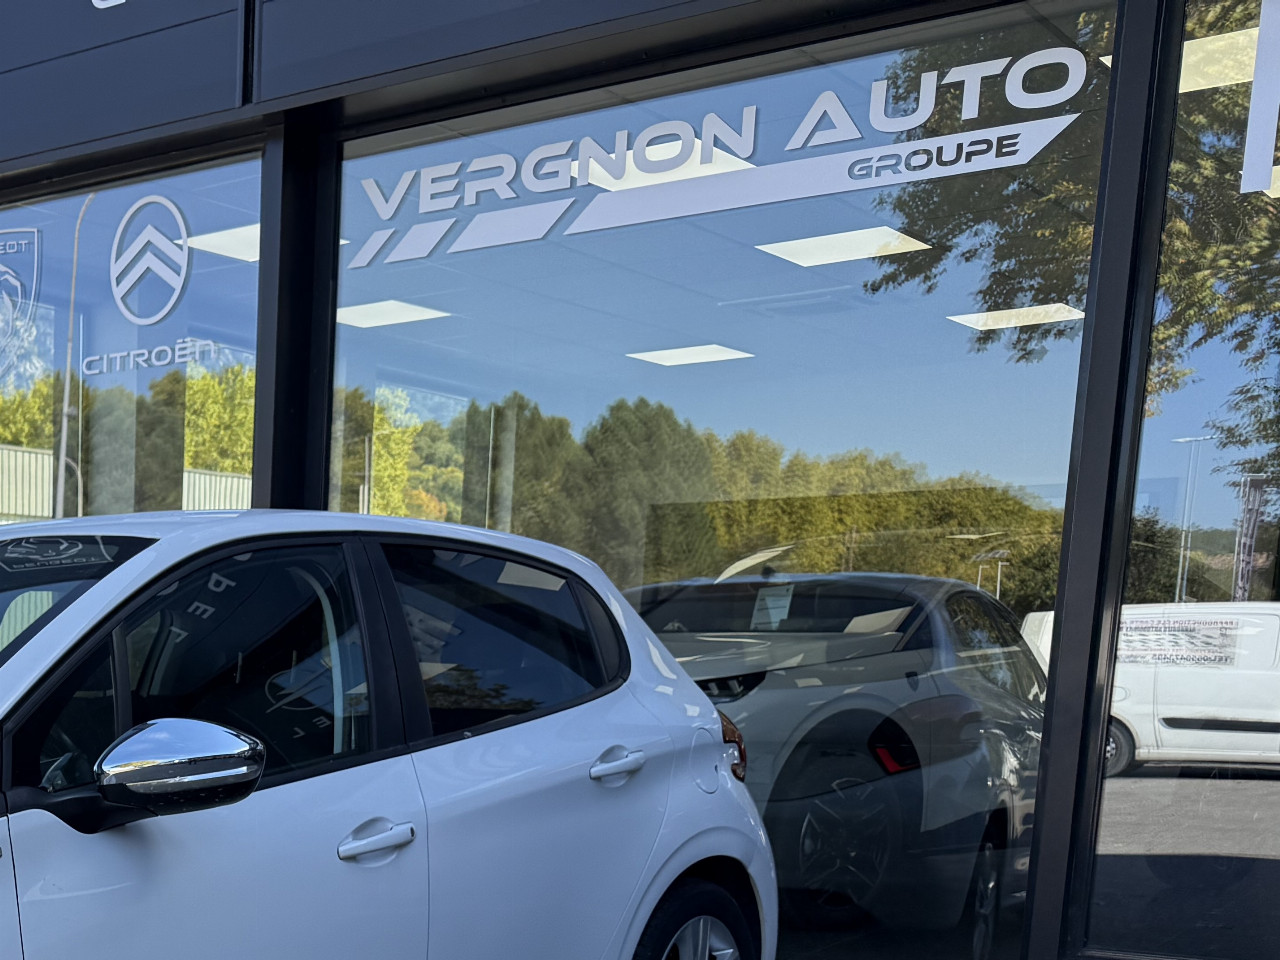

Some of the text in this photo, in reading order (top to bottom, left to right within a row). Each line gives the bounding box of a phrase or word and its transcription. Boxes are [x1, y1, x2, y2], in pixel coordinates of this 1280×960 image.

[360, 46, 1087, 221] VERGNON AUTO
[847, 132, 1022, 181] GROUPE
